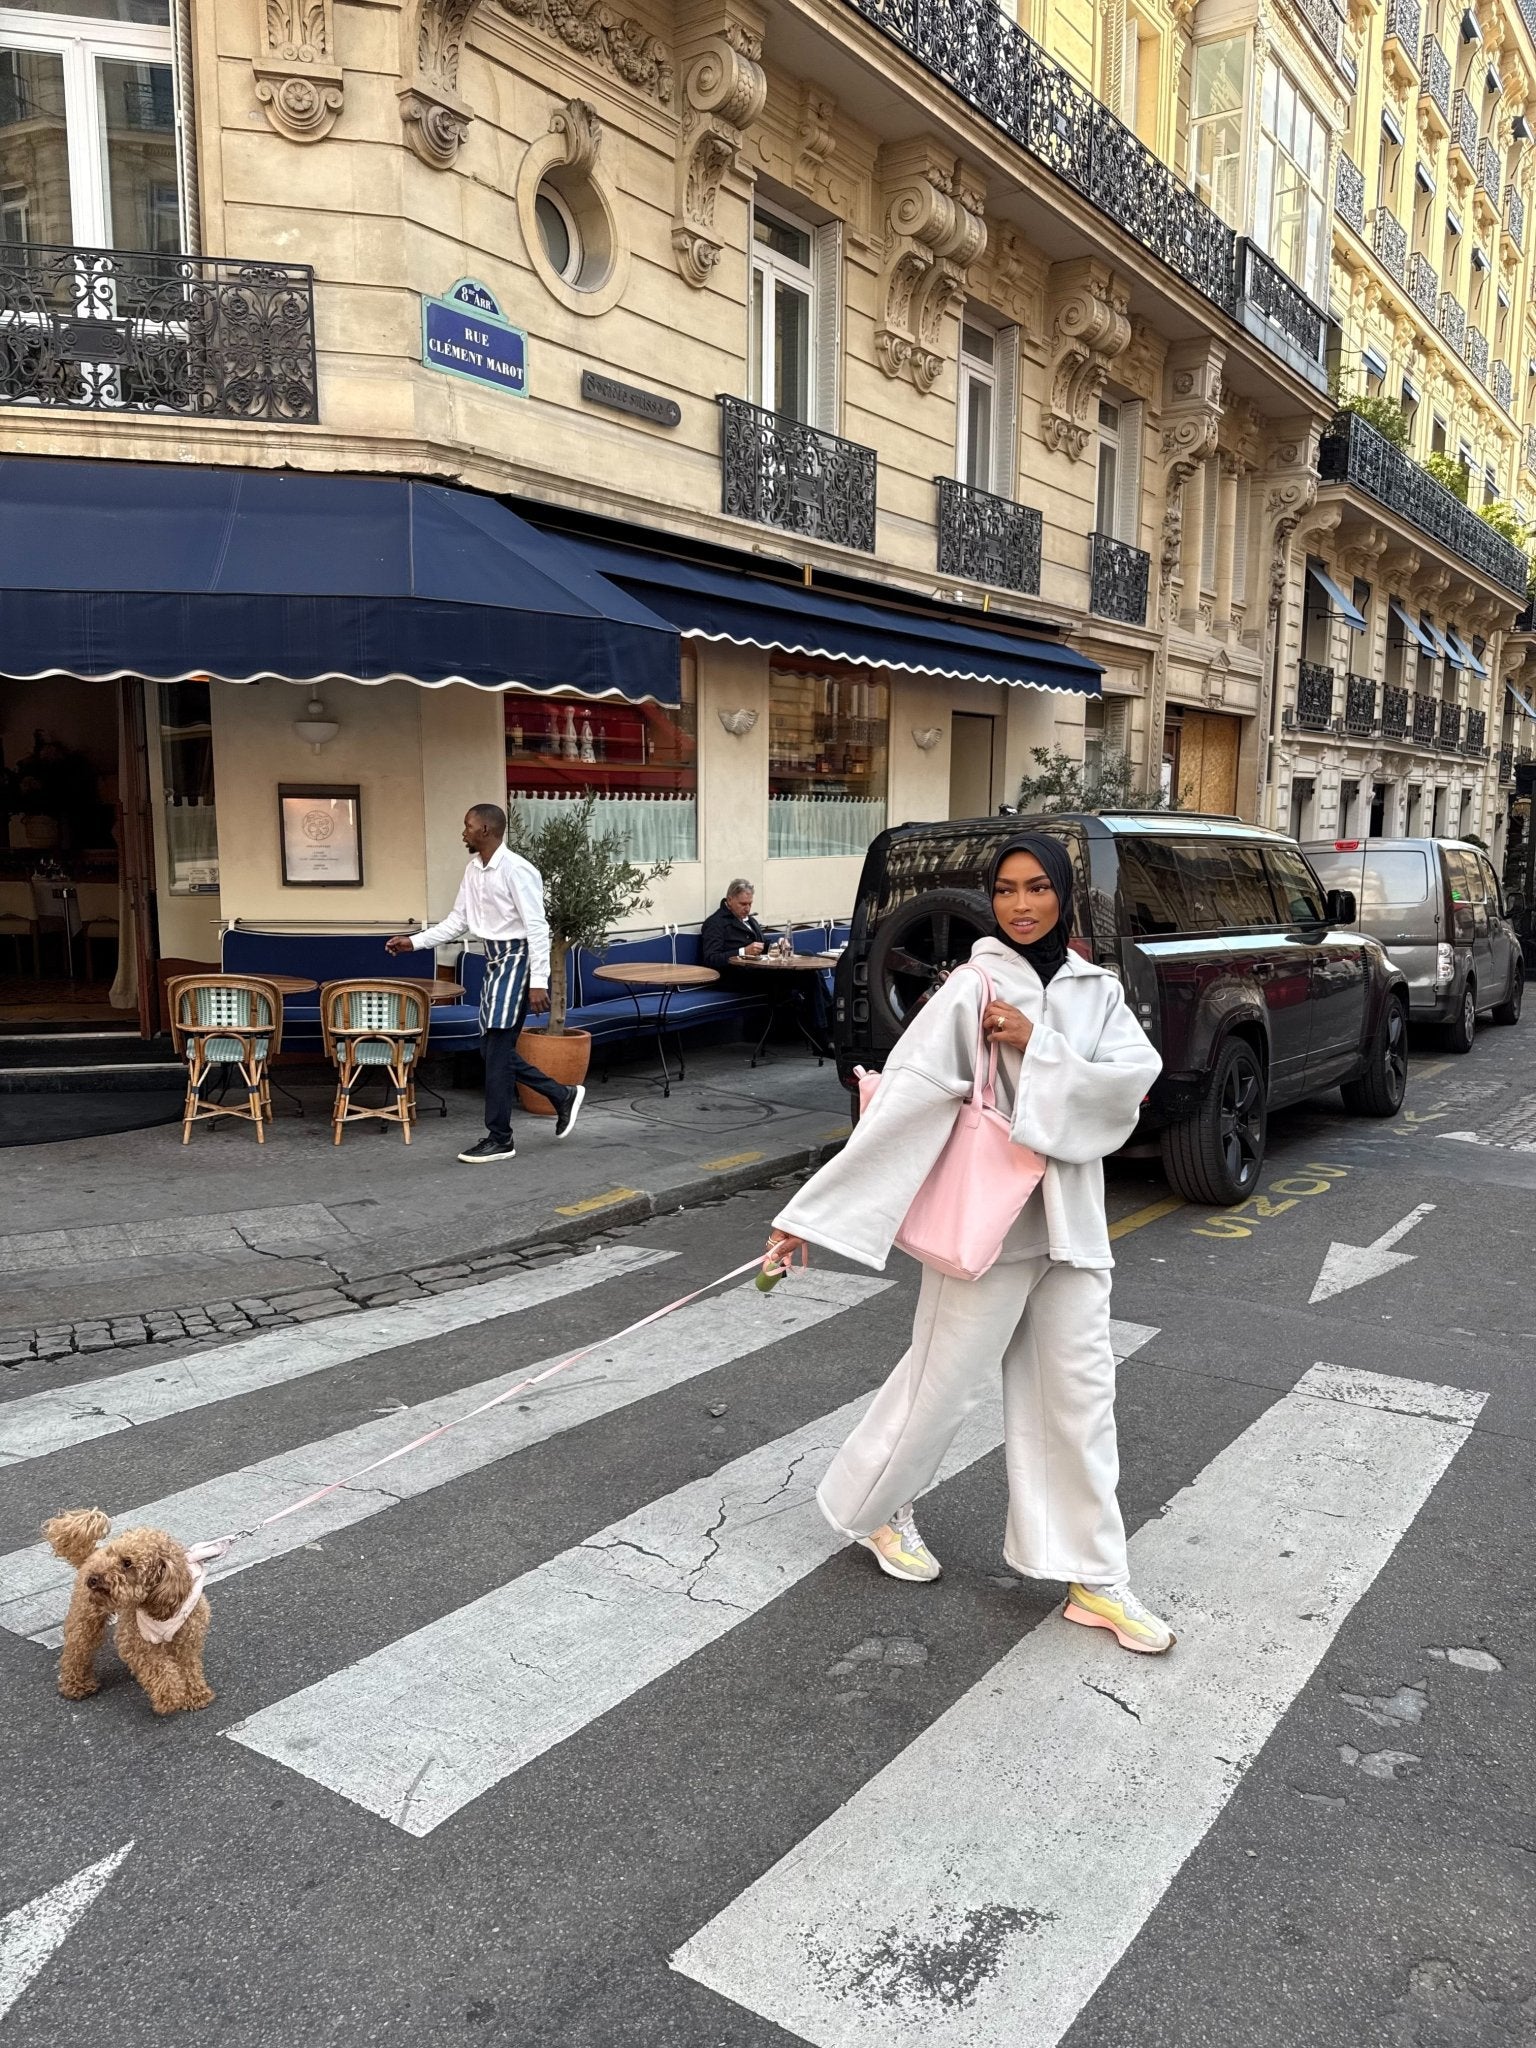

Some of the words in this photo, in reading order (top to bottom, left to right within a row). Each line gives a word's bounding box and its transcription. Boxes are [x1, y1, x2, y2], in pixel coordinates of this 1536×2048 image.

[464, 327, 490, 347] RUE
[428, 338, 483, 367] CLÉMENT
[486, 356, 524, 380] MAROT
